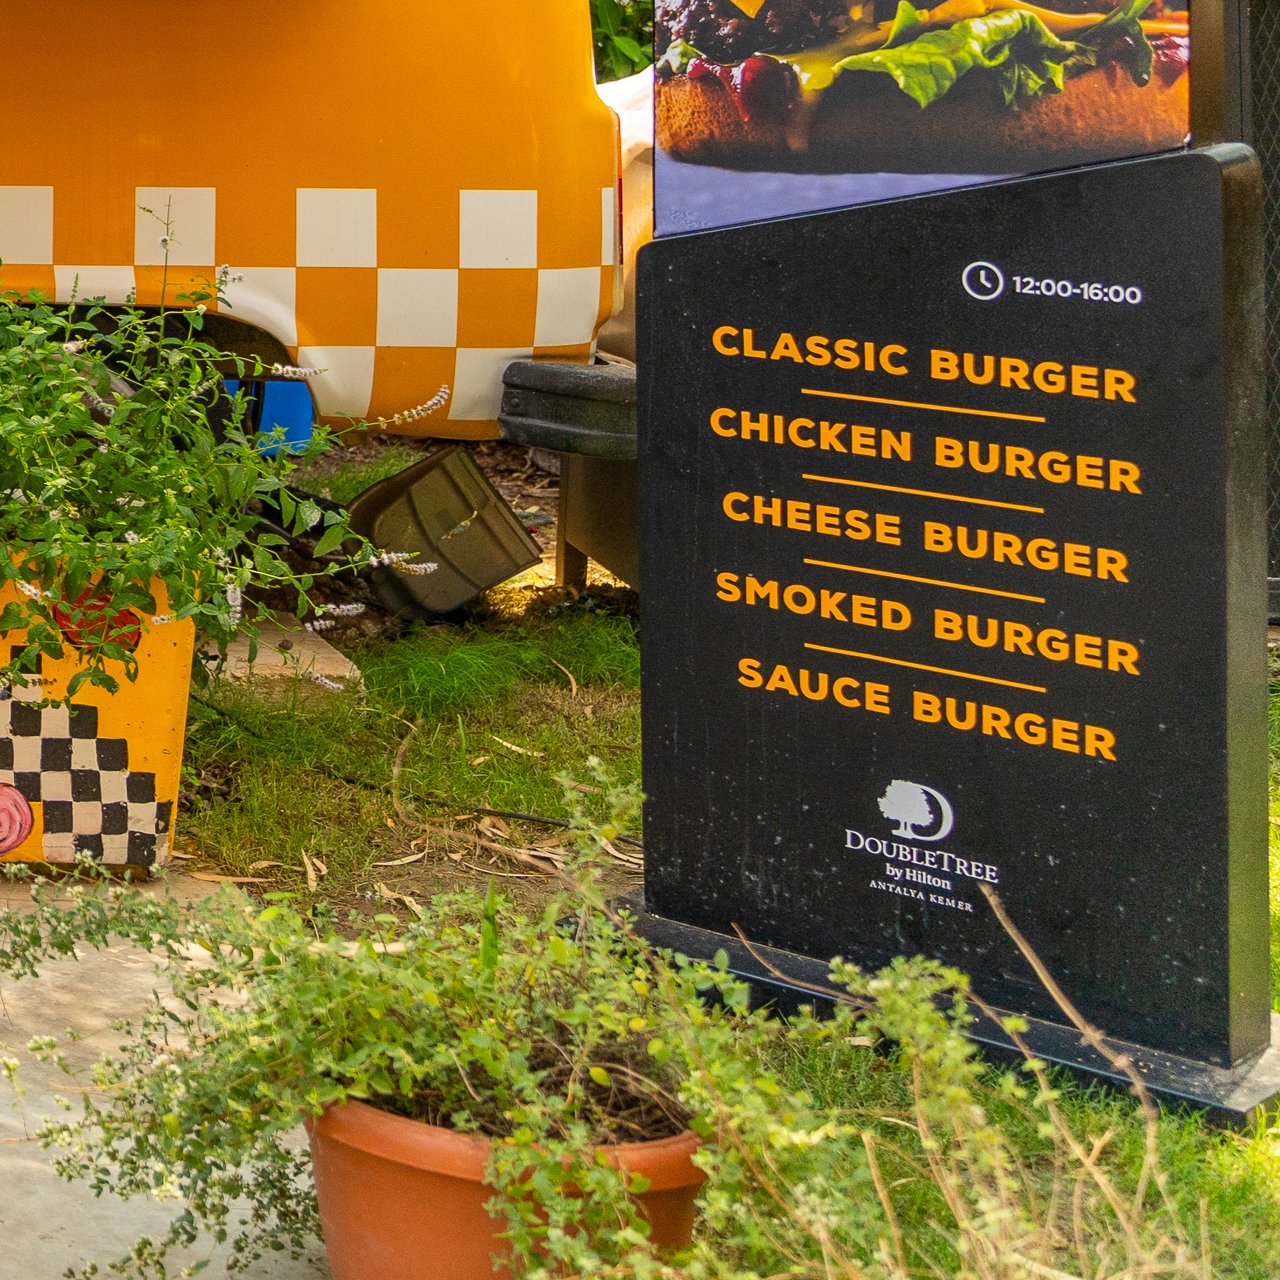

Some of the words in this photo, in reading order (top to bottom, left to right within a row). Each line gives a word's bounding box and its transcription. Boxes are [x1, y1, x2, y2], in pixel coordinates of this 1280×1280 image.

[1012, 274, 1143, 304] 12:00-16:00
[711, 326, 909, 376] CLASSIC
[930, 349, 1138, 404] BURGER
[709, 407, 913, 462] CHICKEN
[934, 436, 1143, 495] BURGER
[721, 491, 902, 547] CHEESE
[923, 520, 1130, 584] BURGER
[715, 572, 912, 633] SMOKED
[933, 608, 1141, 676] BURGER
[737, 657, 892, 715] SAUCE
[912, 690, 1118, 761] BURGER
[870, 880, 925, 900] ANTALYA
[929, 893, 974, 913] KEMER
[885, 862, 903, 881] by
[906, 868, 952, 890] Hilton
